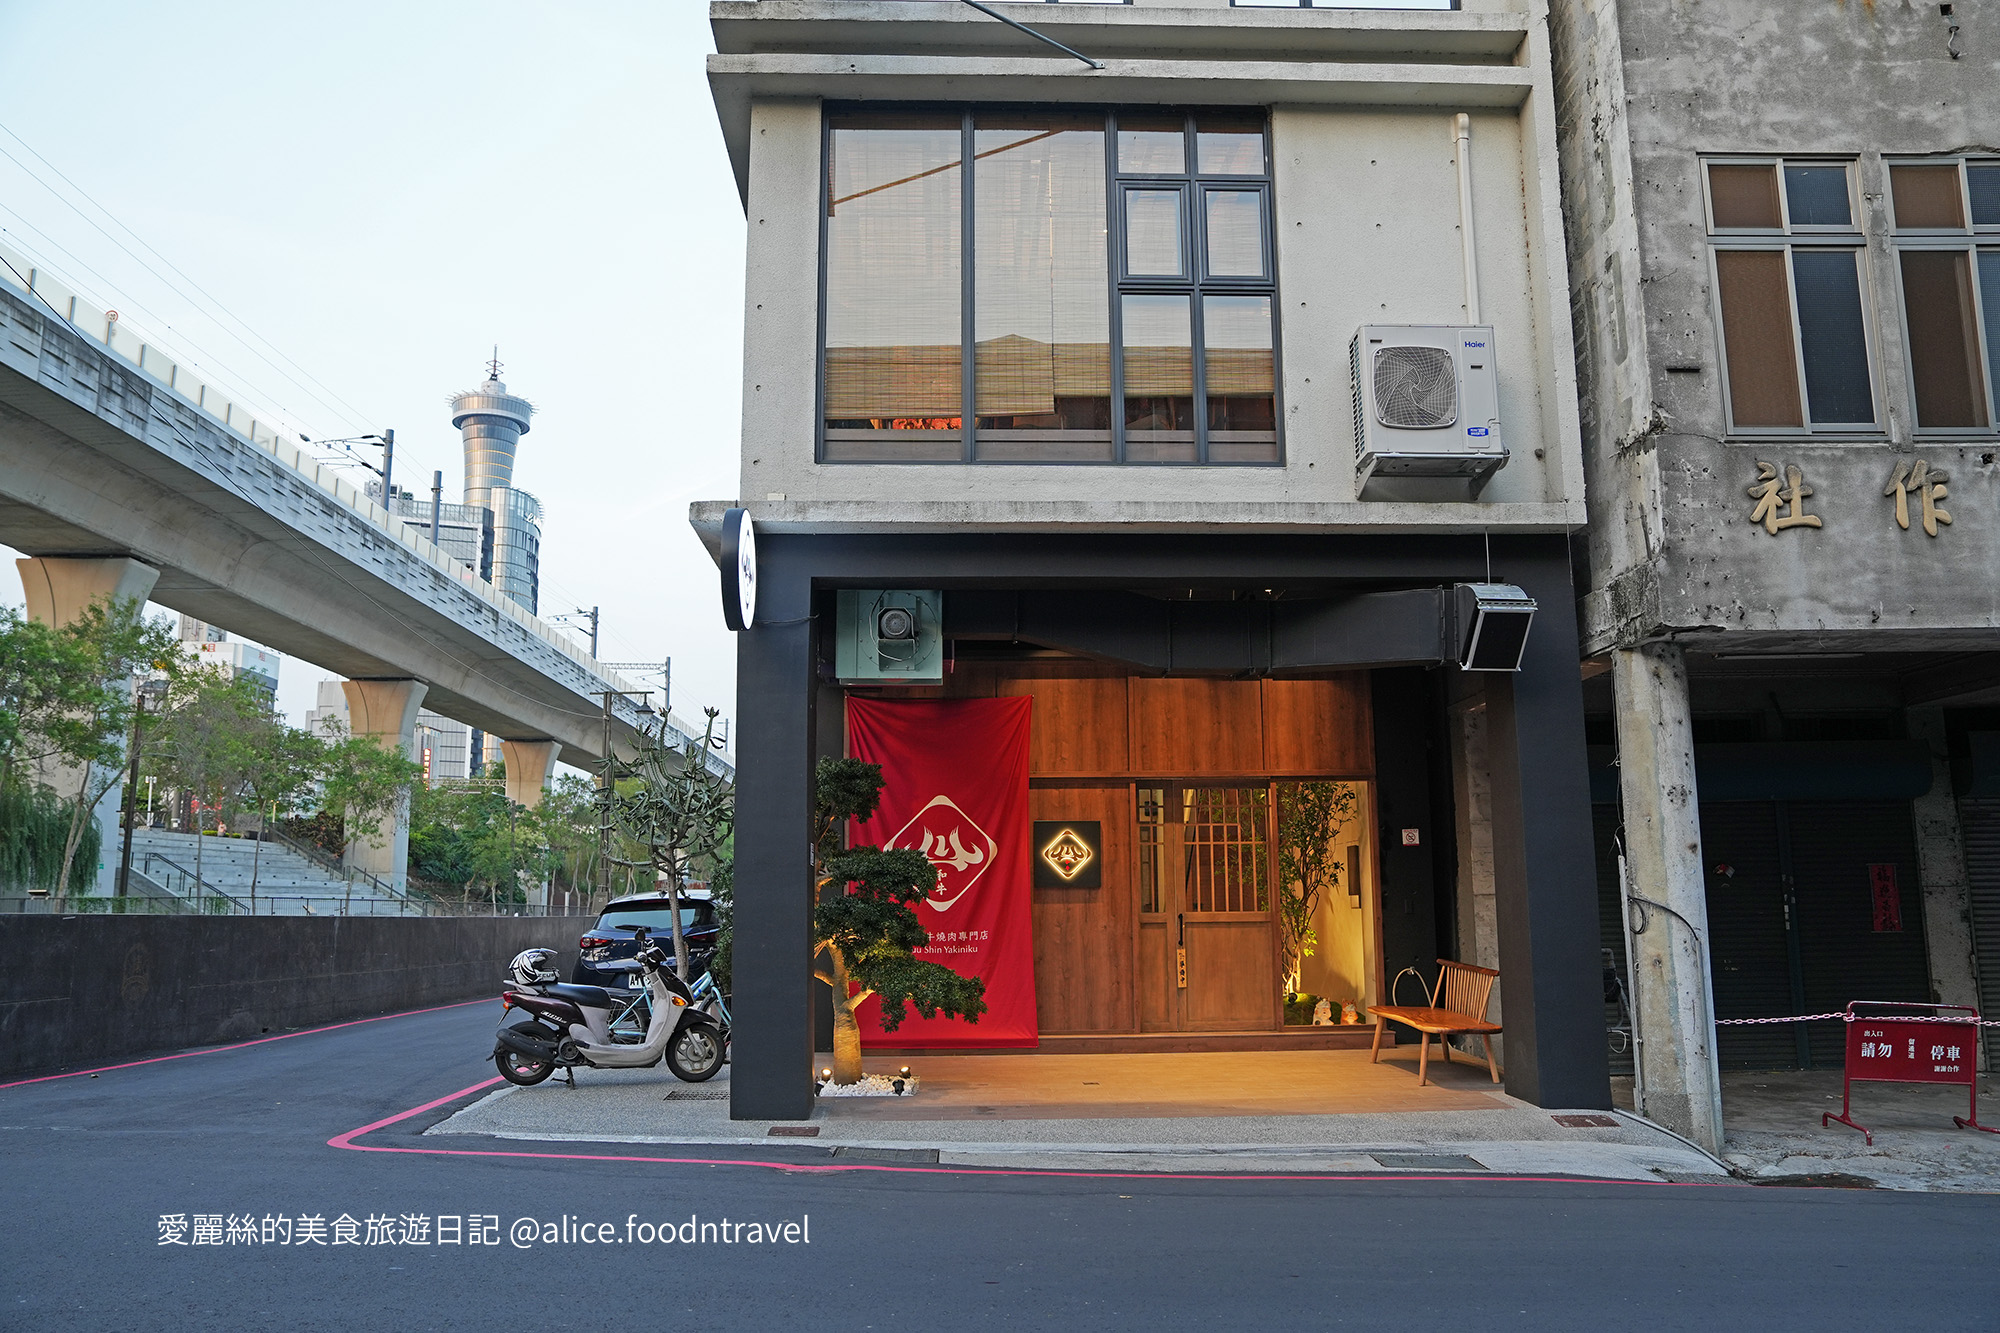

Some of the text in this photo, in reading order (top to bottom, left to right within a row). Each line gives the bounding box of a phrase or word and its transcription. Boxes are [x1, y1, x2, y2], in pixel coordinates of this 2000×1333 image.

[1747, 459, 1953, 537] 社 作
[936, 869, 947, 895] 和牛
[924, 945, 942, 954] Shin
[943, 944, 978, 954] Yakiniku
[1861, 1042, 1960, 1061] 請勿 停車
[1934, 1065, 1960, 1073] 謝謝合作
